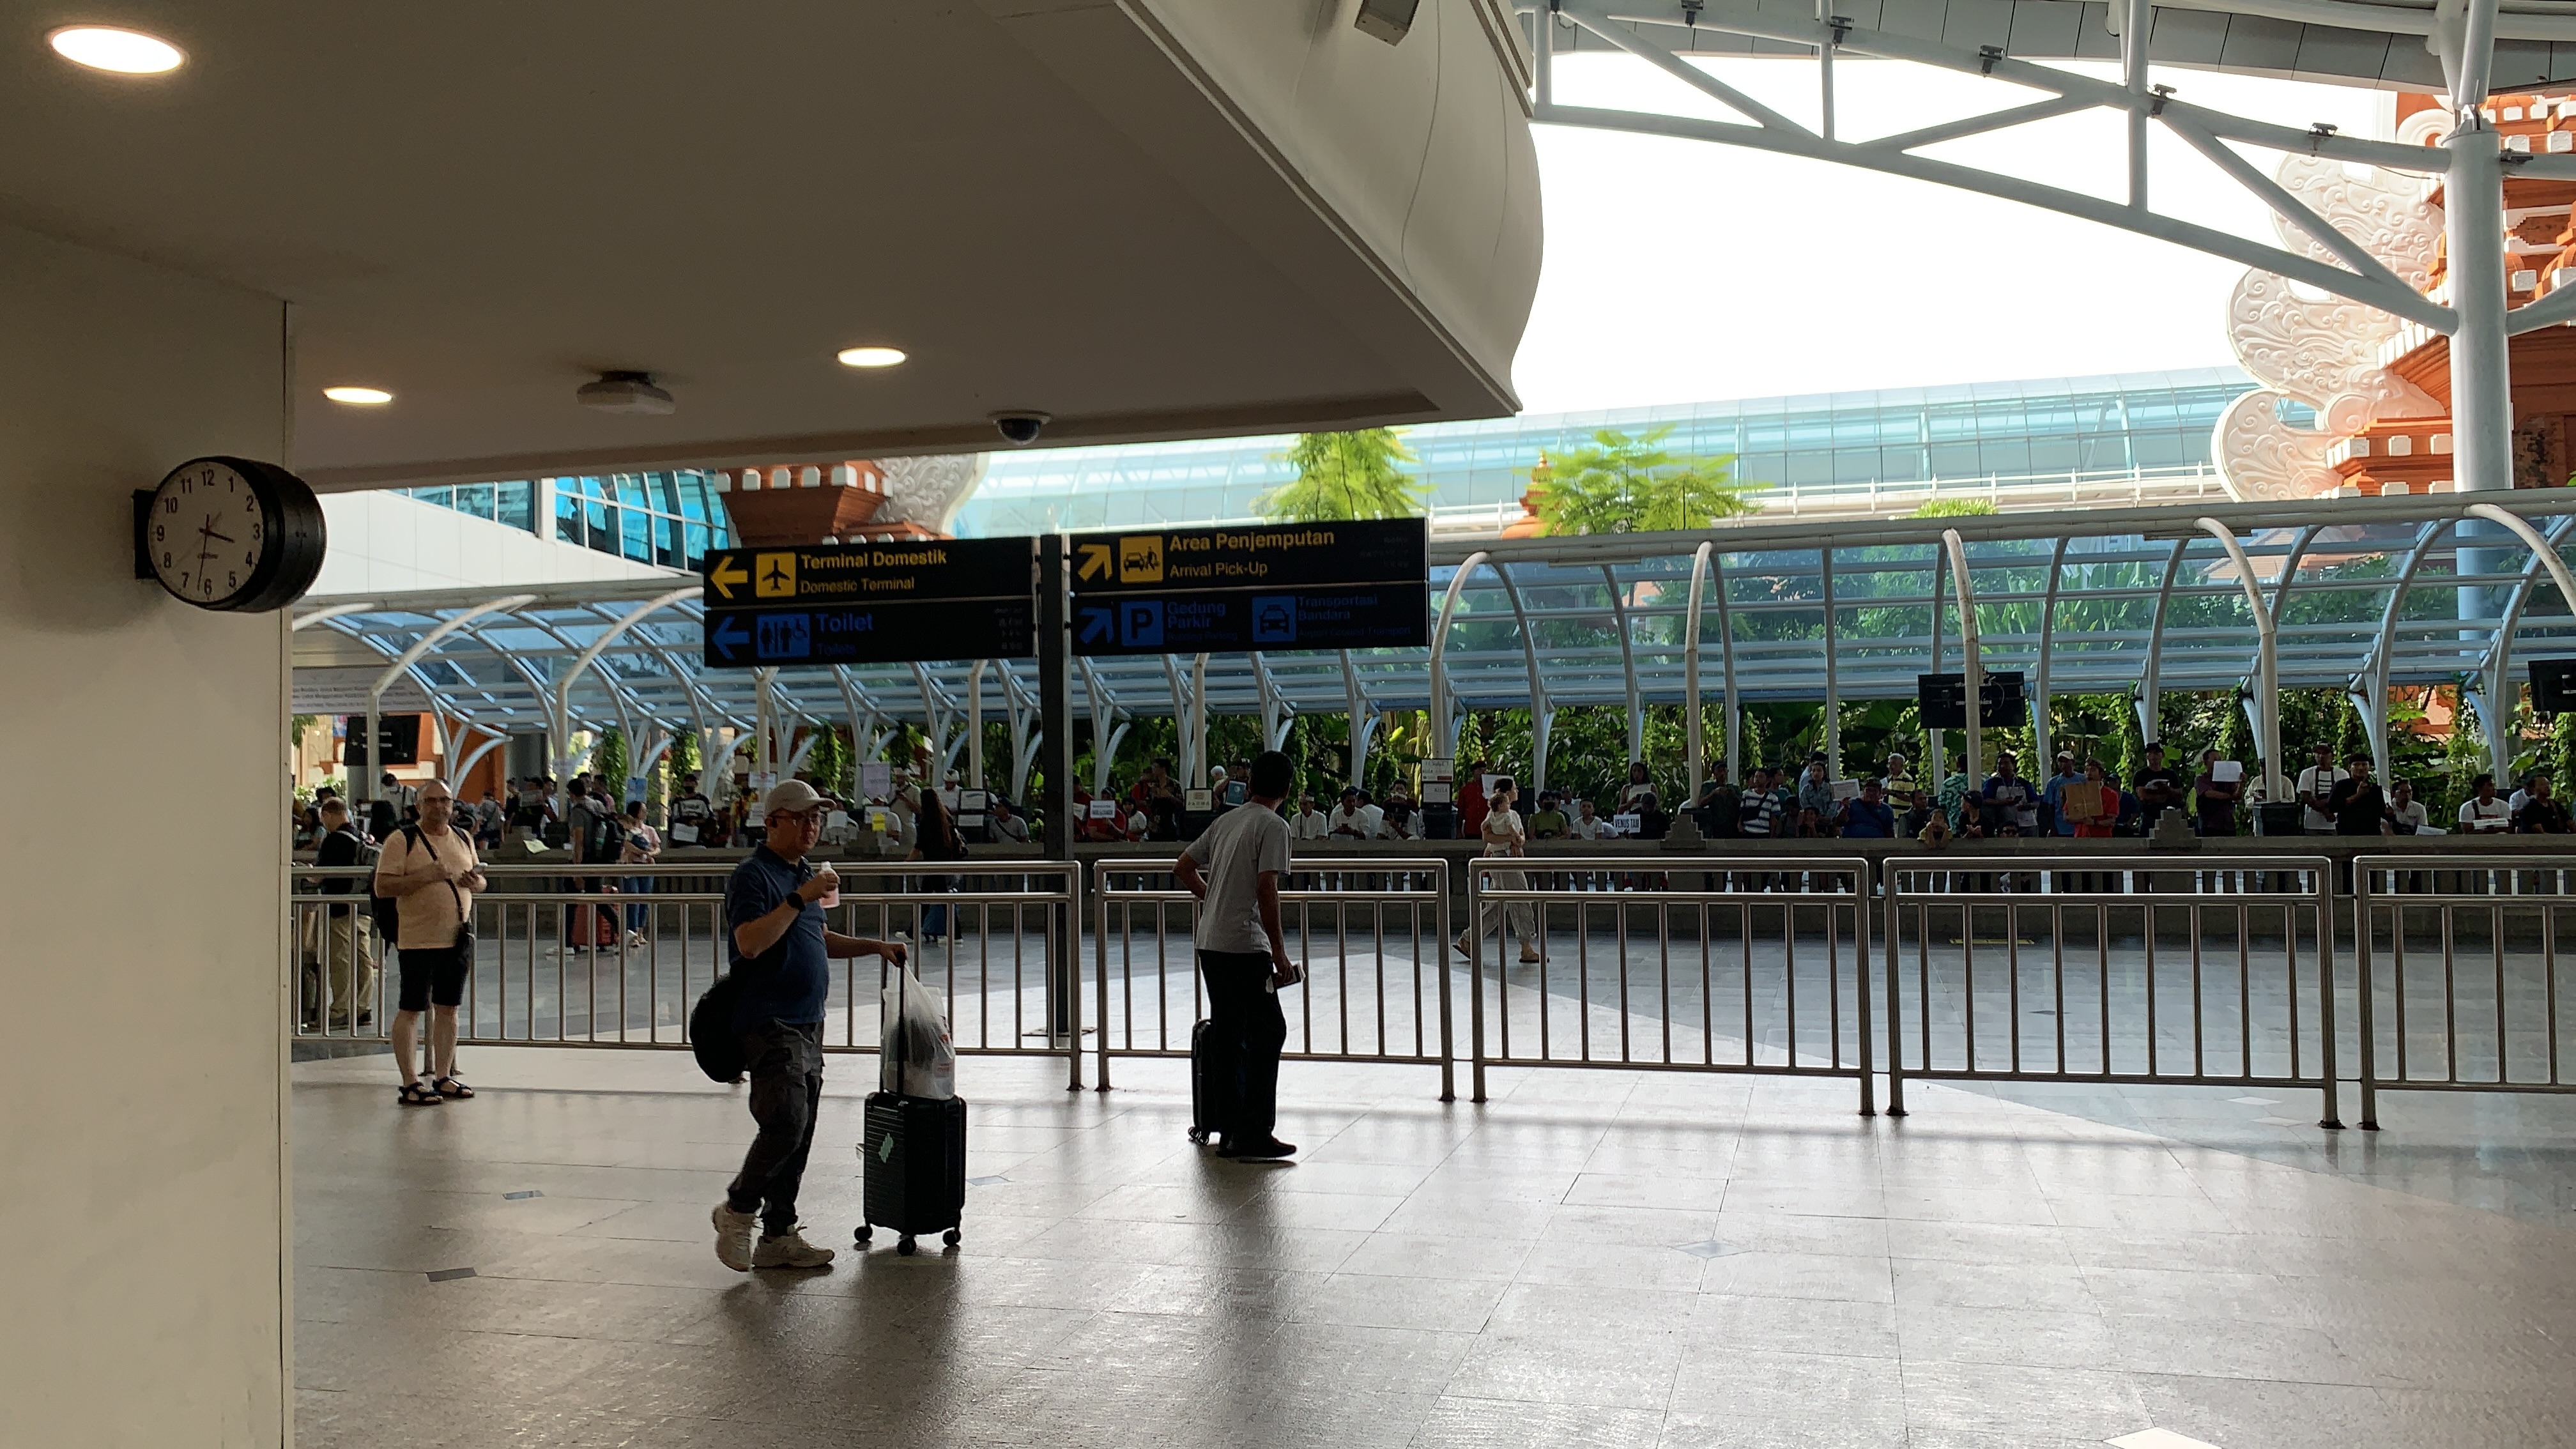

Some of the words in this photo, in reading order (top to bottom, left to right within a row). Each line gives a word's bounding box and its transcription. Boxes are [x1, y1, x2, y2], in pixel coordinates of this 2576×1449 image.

[180, 477, 192, 494] 11
[201, 469, 215, 487] 12
[228, 476, 234, 493] 1
[164, 496, 178, 514] 10
[247, 494, 254, 512] 2
[157, 525, 164, 542] 9
[253, 523, 260, 540] 3
[1169, 534, 1210, 552] Area
[1215, 530, 1335, 553] Penjemputan
[164, 552, 172, 569] 8
[245, 551, 253, 567] 4
[801, 552, 868, 570] Terminal
[873, 550, 947, 566] Domestik
[1169, 563, 1211, 579] Arrival
[1216, 560, 1269, 578] Pick-Up
[182, 572, 189, 588] 7
[204, 578, 212, 595] 6
[229, 571, 236, 588] 5
[800, 579, 857, 594] Domestic
[861, 576, 915, 591] Terminal
[1167, 601, 1227, 618] Gedung
[1298, 594, 1379, 608] Transportasi
[815, 612, 875, 633] Toilet
[1131, 608, 1153, 639] P
[1168, 614, 1212, 629] Parkir
[1298, 609, 1351, 621] Bandara
[816, 643, 857, 656] Toilets
